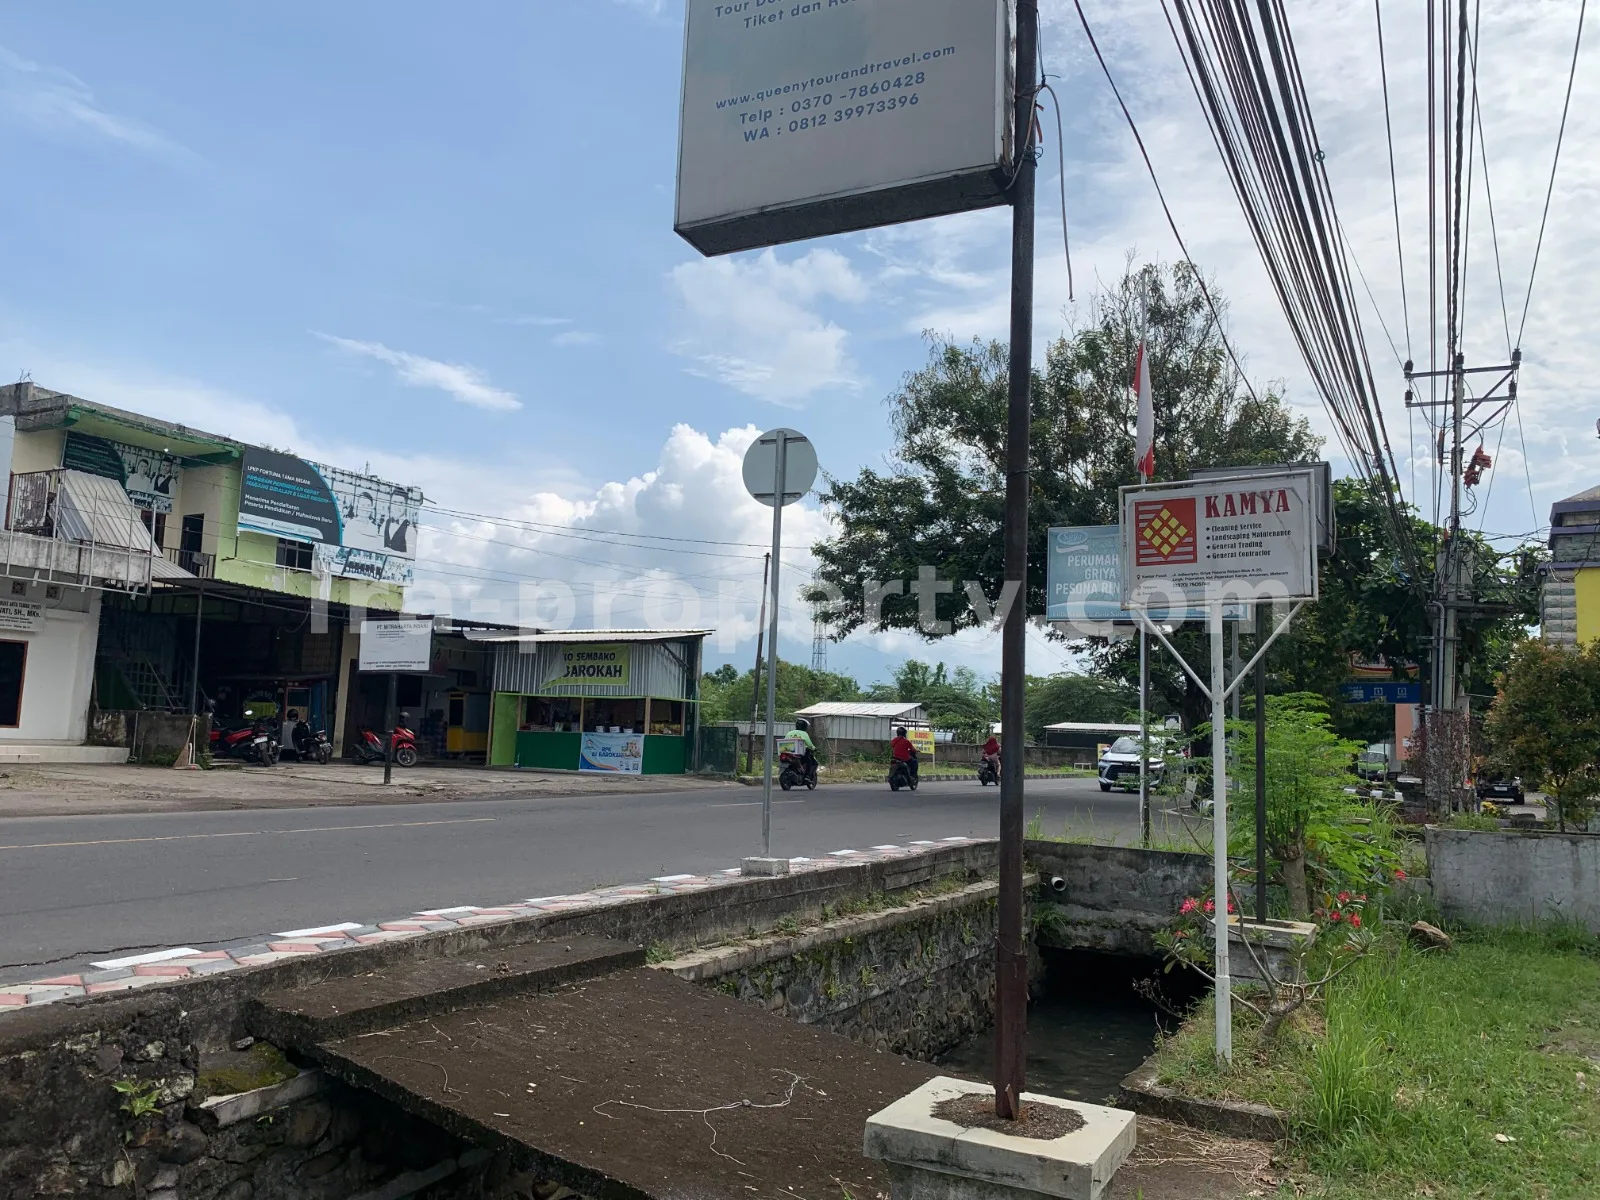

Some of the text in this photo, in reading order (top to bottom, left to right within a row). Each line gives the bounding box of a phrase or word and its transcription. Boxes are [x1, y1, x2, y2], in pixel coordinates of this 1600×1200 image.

[714, 0, 749, 17] Tour
[743, 9, 784, 29] Tiket
[790, 1, 821, 17] dan
[715, 46, 955, 109] www.queenytourandtravel.com
[740, 109, 773, 125] Telp
[791, 93, 833, 113] 0370
[743, 127, 770, 143] WA
[788, 113, 827, 133] 0812
[833, 93, 919, 122] 39973396
[246, 474, 273, 485] PROGRAM
[244, 494, 300, 510] Menerima Pendaftaran
[1204, 489, 1290, 518] KAMYA
[244, 500, 264, 509] Peserta
[264, 504, 292, 515] Pendidikan
[295, 511, 321, 521] Mahasiswa
[320, 516, 333, 524] Baru
[1211, 522, 1262, 532] Cleaning Service
[1211, 529, 1291, 541] Landscaping Maintenance
[1212, 542, 1237, 550] General
[1212, 549, 1271, 559] General Contractor
[1084, 567, 1116, 580] GRIYA
[1055, 582, 1098, 595] PESONA
[576, 652, 616, 661] SEMBAKO
